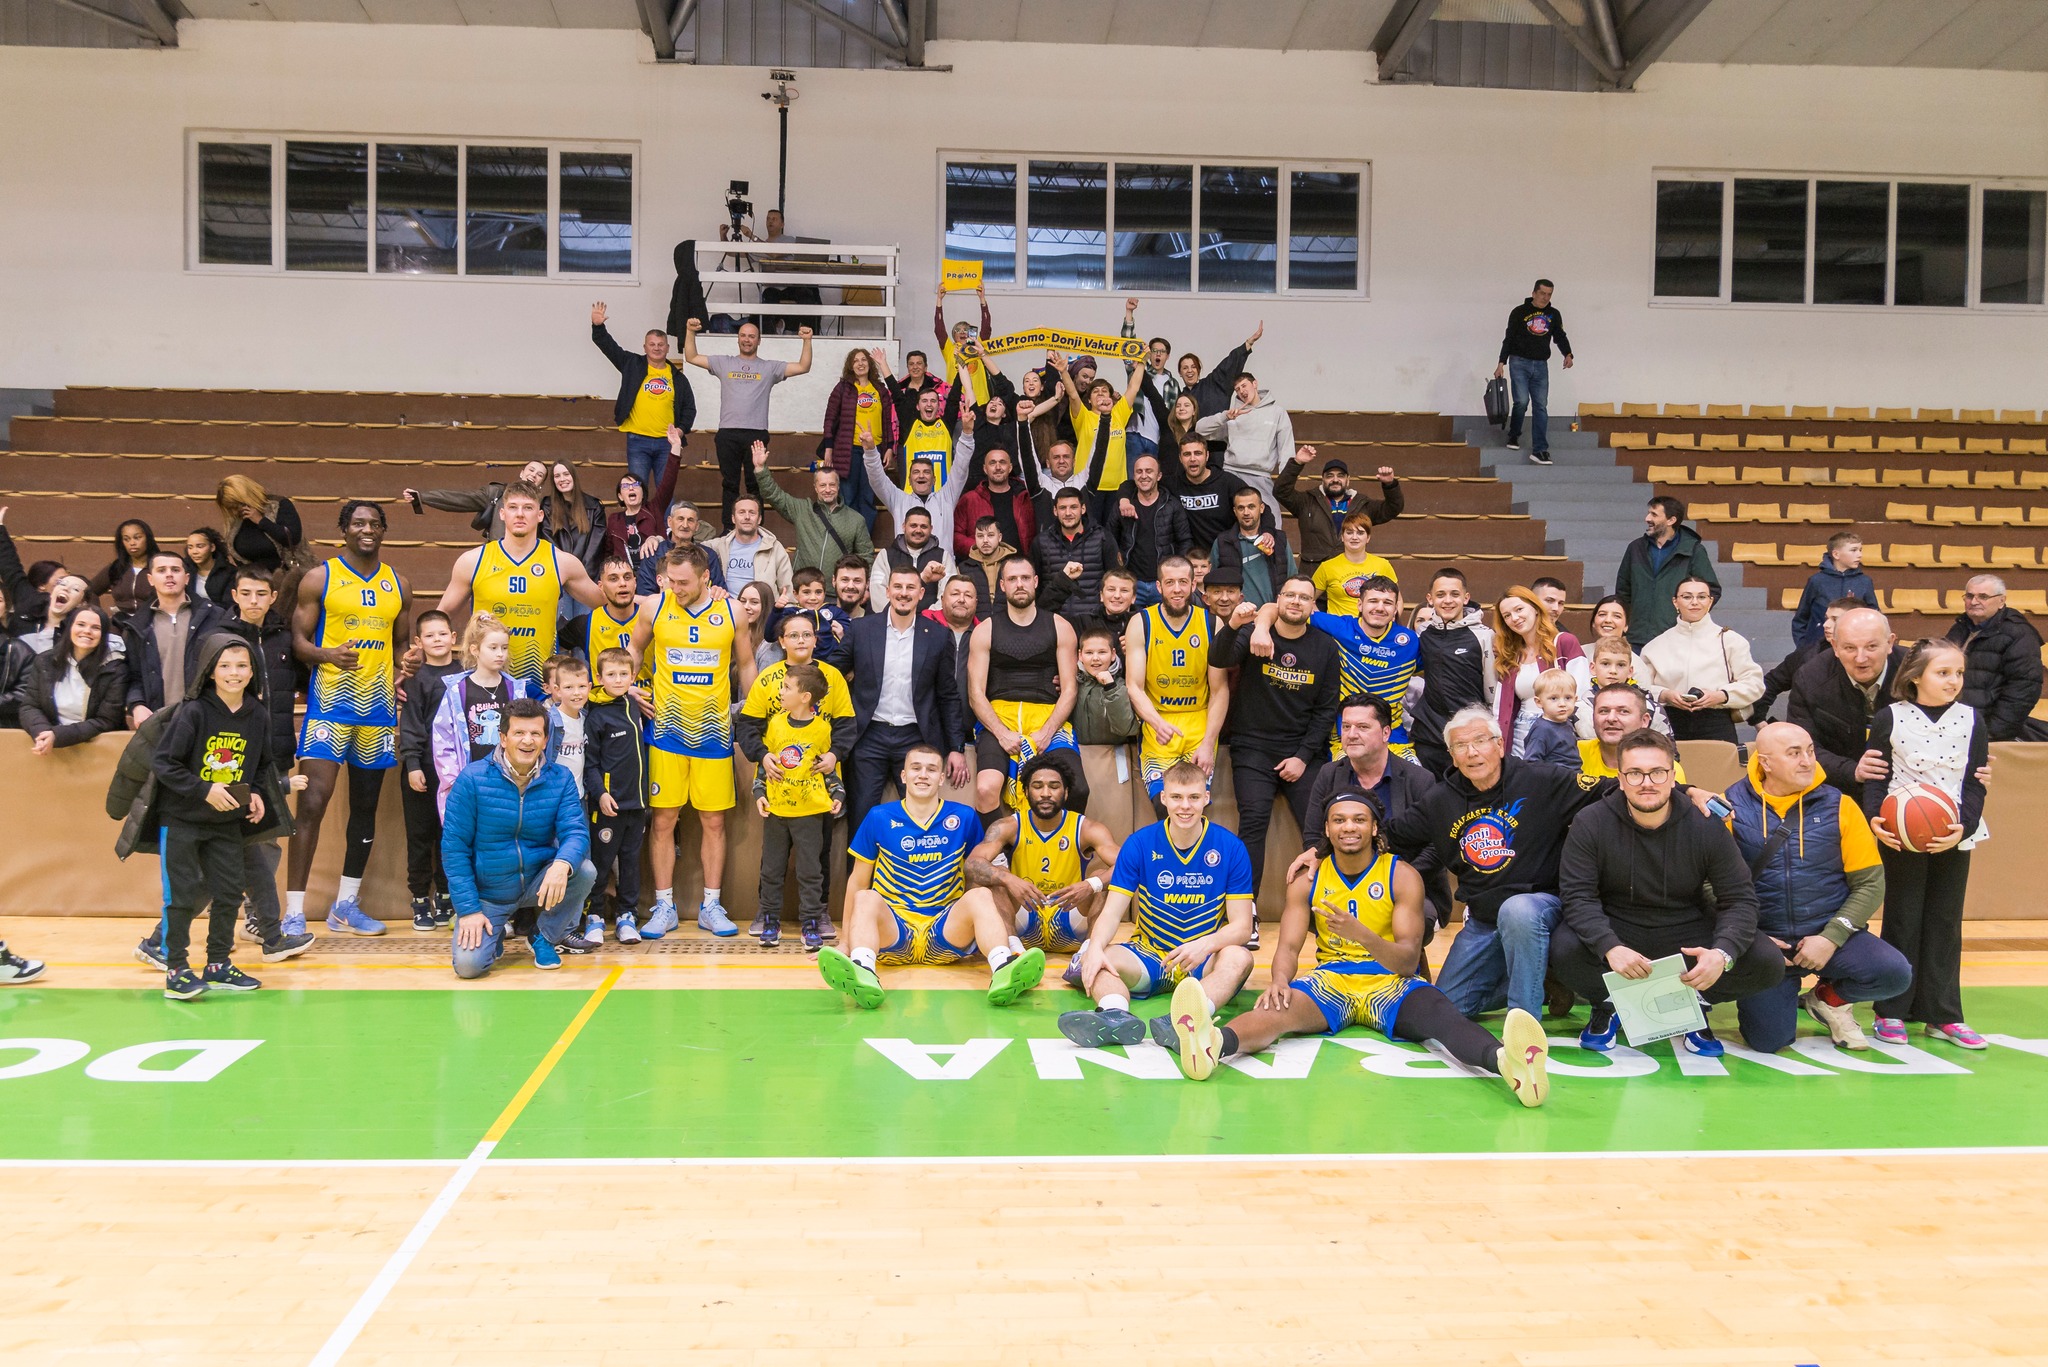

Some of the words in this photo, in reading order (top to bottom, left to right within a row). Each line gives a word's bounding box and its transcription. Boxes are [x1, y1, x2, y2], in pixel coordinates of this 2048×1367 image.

[986, 338, 1004, 351] KK
[1085, 338, 1119, 352] Vakuf
[644, 382, 672, 392] Promo
[509, 576, 527, 594] 50
[361, 589, 377, 607] 13
[689, 626, 699, 643] 5
[1171, 649, 1185, 667] 12
[1268, 667, 1308, 682] PROMO
[206, 736, 248, 752] GRINCH
[1497, 808, 1519, 828] KLUB
[1459, 827, 1490, 850] Donji
[1471, 838, 1505, 852] Vakuf
[1041, 857, 1050, 873] 2
[1176, 875, 1214, 885] PROMO
[1348, 899, 1358, 919] 8
